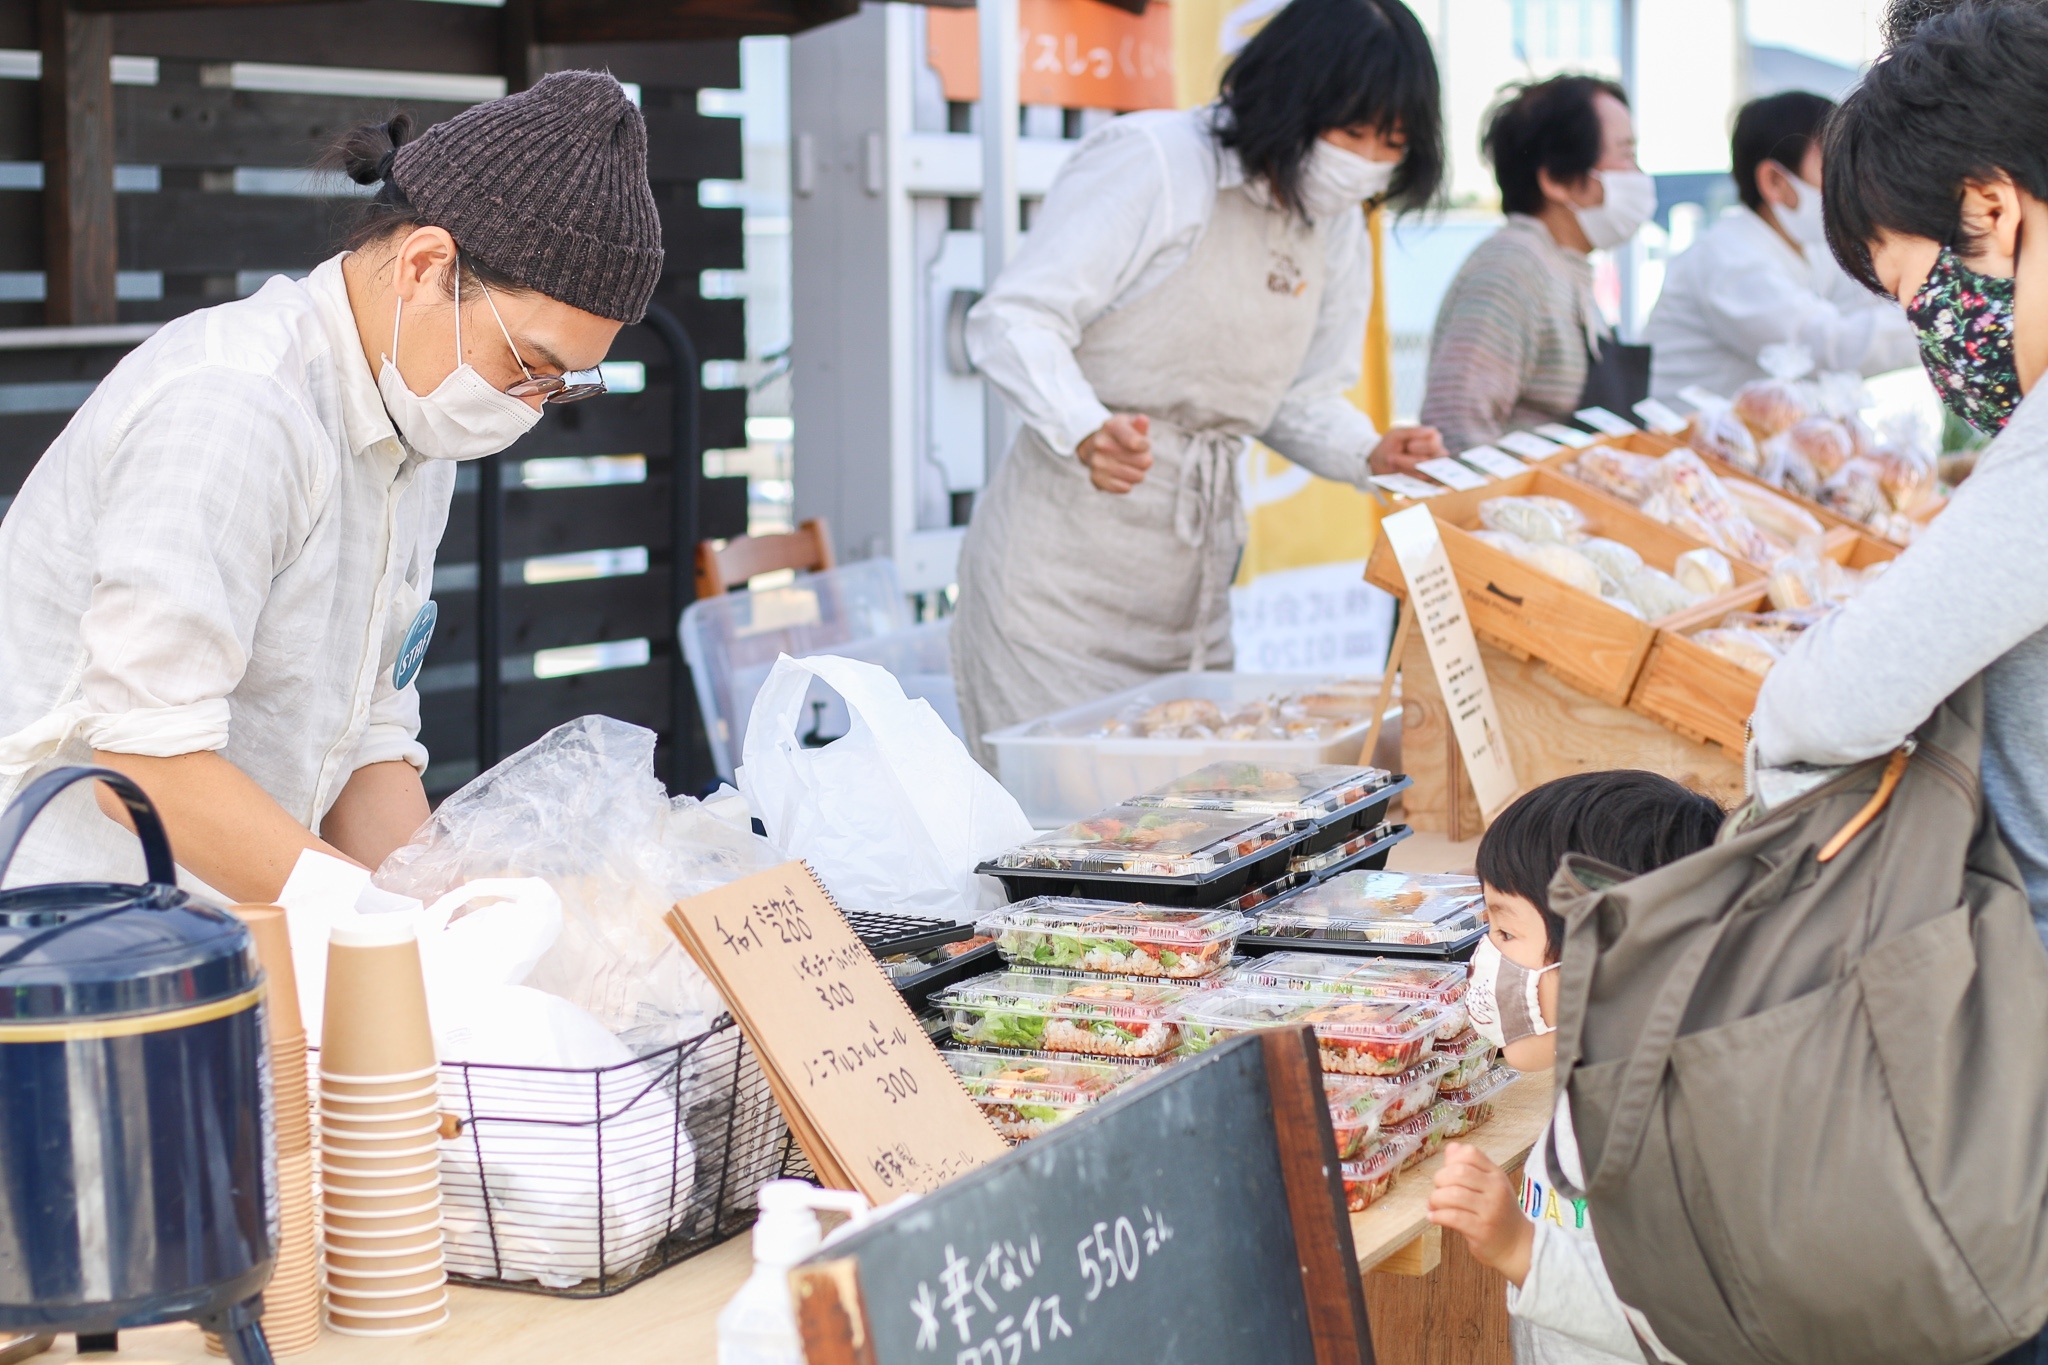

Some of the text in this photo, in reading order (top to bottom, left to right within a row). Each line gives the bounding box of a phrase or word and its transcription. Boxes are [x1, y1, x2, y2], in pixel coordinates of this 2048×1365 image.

[772, 916, 812, 943] 200
[816, 981, 854, 1011] 300
[877, 1066, 918, 1104] 300
[1518, 1173, 1588, 1228] IDAY
